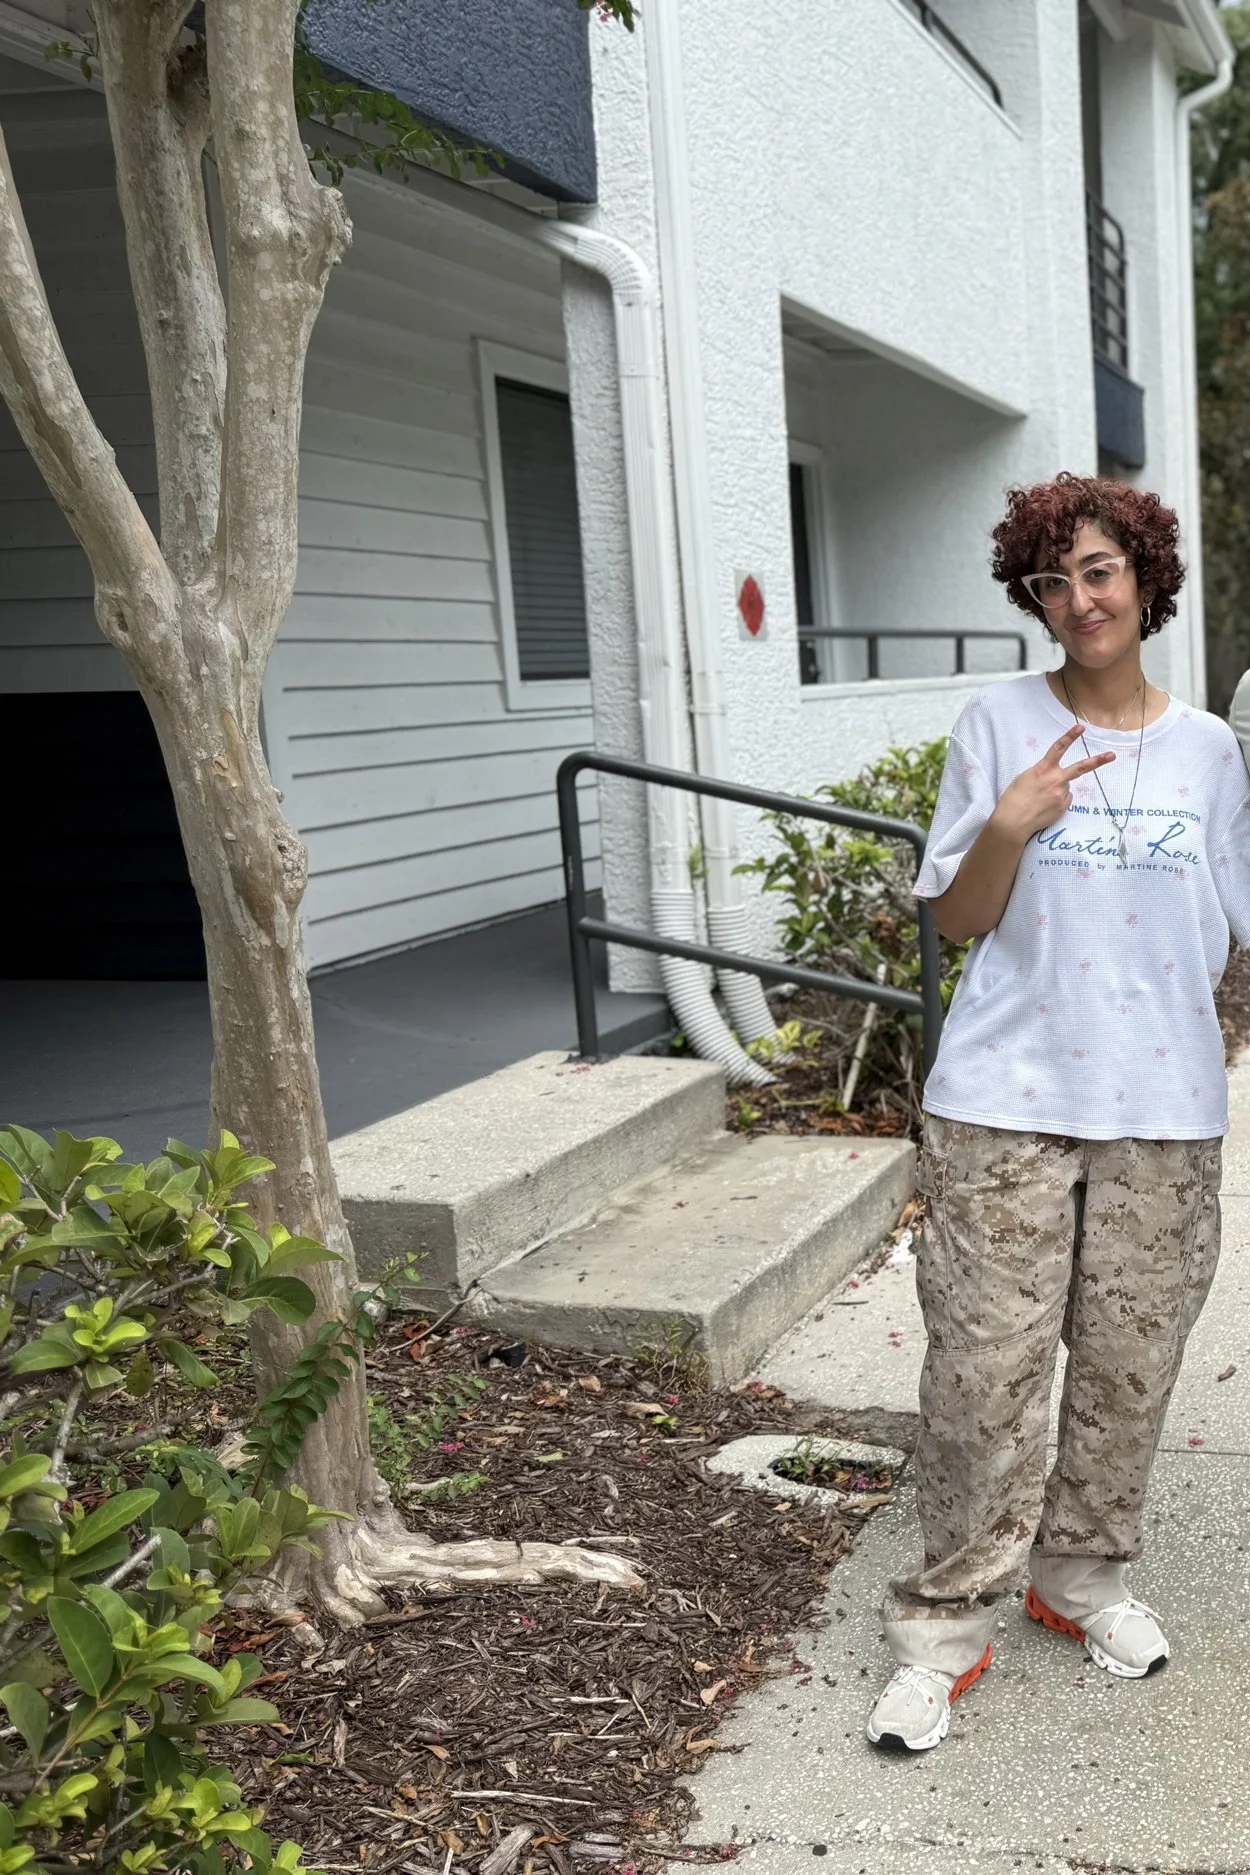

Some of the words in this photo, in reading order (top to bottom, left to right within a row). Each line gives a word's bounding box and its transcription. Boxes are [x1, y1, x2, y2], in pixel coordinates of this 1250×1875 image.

[1067, 804, 1090, 814] UMN
[1092, 806, 1100, 816] &
[1103, 807, 1144, 816] WINTER
[1147, 809, 1201, 823] COLLECTION
[1037, 827, 1121, 857] Martin
[1147, 820, 1201, 865] Rose
[1038, 859, 1090, 868] PRODUCED
[1097, 862, 1106, 871] by
[1116, 863, 1158, 872] MARTINE
[1162, 864, 1184, 875] ROSE
